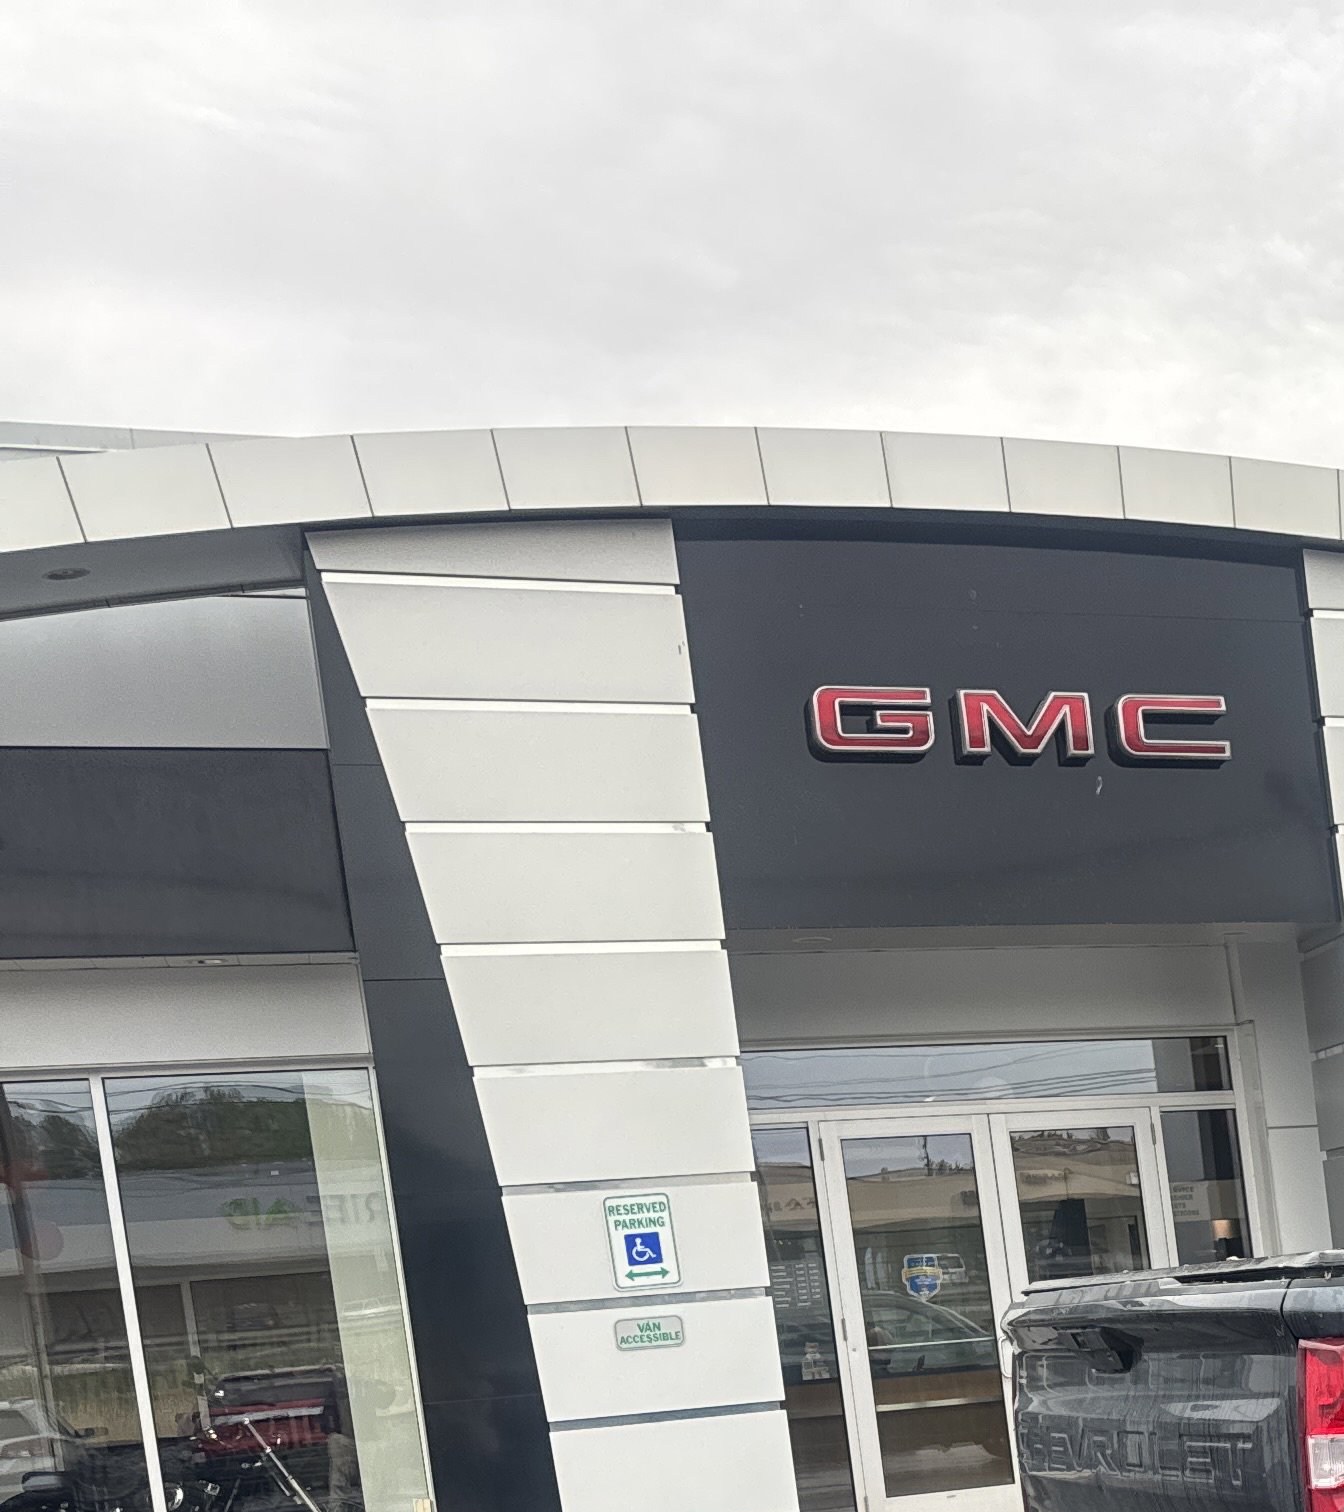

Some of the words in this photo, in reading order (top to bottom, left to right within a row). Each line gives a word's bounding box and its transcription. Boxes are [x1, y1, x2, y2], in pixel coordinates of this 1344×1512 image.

[808, 685, 1233, 763] GMC
[607, 1201, 667, 1217] RESERVED
[613, 1216, 666, 1232] PARKING
[636, 1321, 661, 1334] VAN
[619, 1331, 681, 1345] ACCESSIBLE
